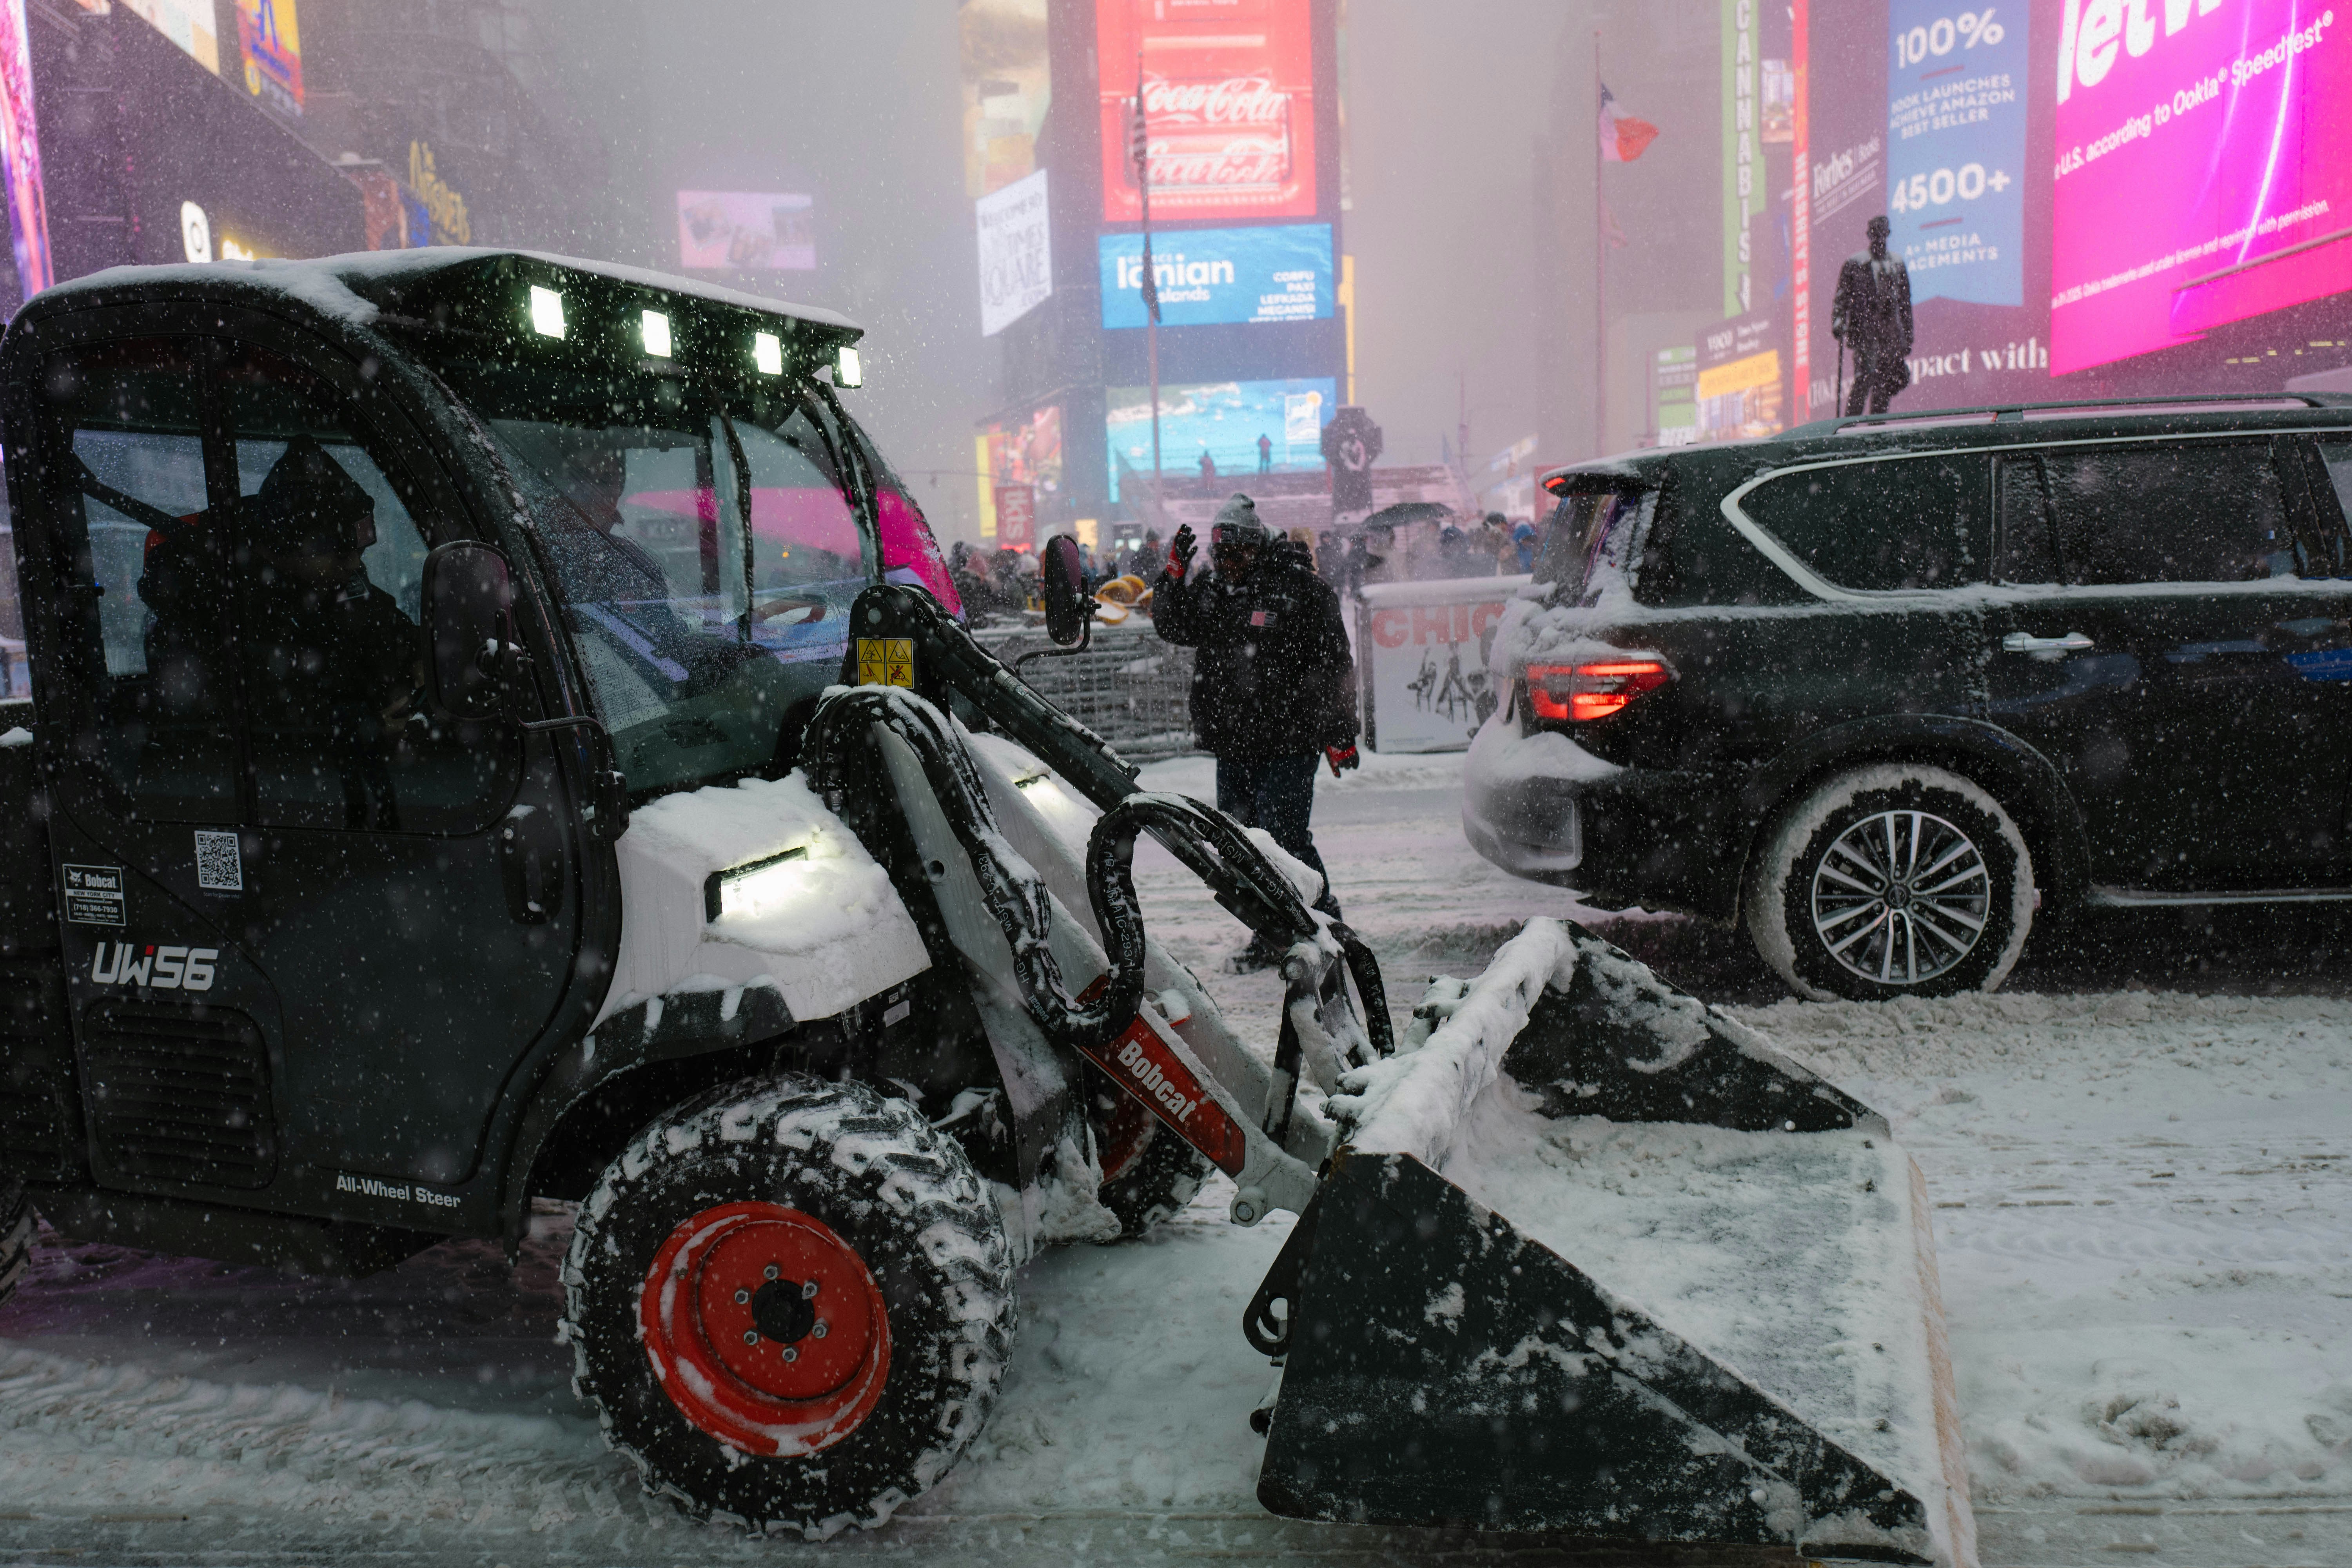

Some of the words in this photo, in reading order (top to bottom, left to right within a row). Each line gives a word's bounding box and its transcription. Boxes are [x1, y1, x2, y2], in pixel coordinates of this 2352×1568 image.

[1896, 8, 2005, 69] 100%
[1923, 73, 2011, 103] LAUNCHES
[1940, 89, 2015, 113] AMAZON
[1736, 0, 1751, 262] CANNABIS
[1932, 107, 1990, 130] SELLER
[2061, 146, 2085, 175] U.S.
[2085, 114, 2151, 162] according
[2154, 103, 2171, 126] to
[1891, 163, 2011, 214] 4500+
[1926, 233, 1982, 253] MEDIA
[1908, 245, 1998, 273] ACEMENTS
[1157, 287, 1210, 304] slands
[1905, 346, 1971, 385] pact
[1980, 336, 2049, 371] with
[1004, 490, 1028, 539] tkts
[1211, 832, 1245, 863] MSHA
[85, 874, 116, 888] Bobcat
[74, 903, 88, 912] (718)
[92, 942, 219, 991] UW56
[336, 1175, 410, 1201] All-Wheel
[416, 1187, 461, 1208] Steer
